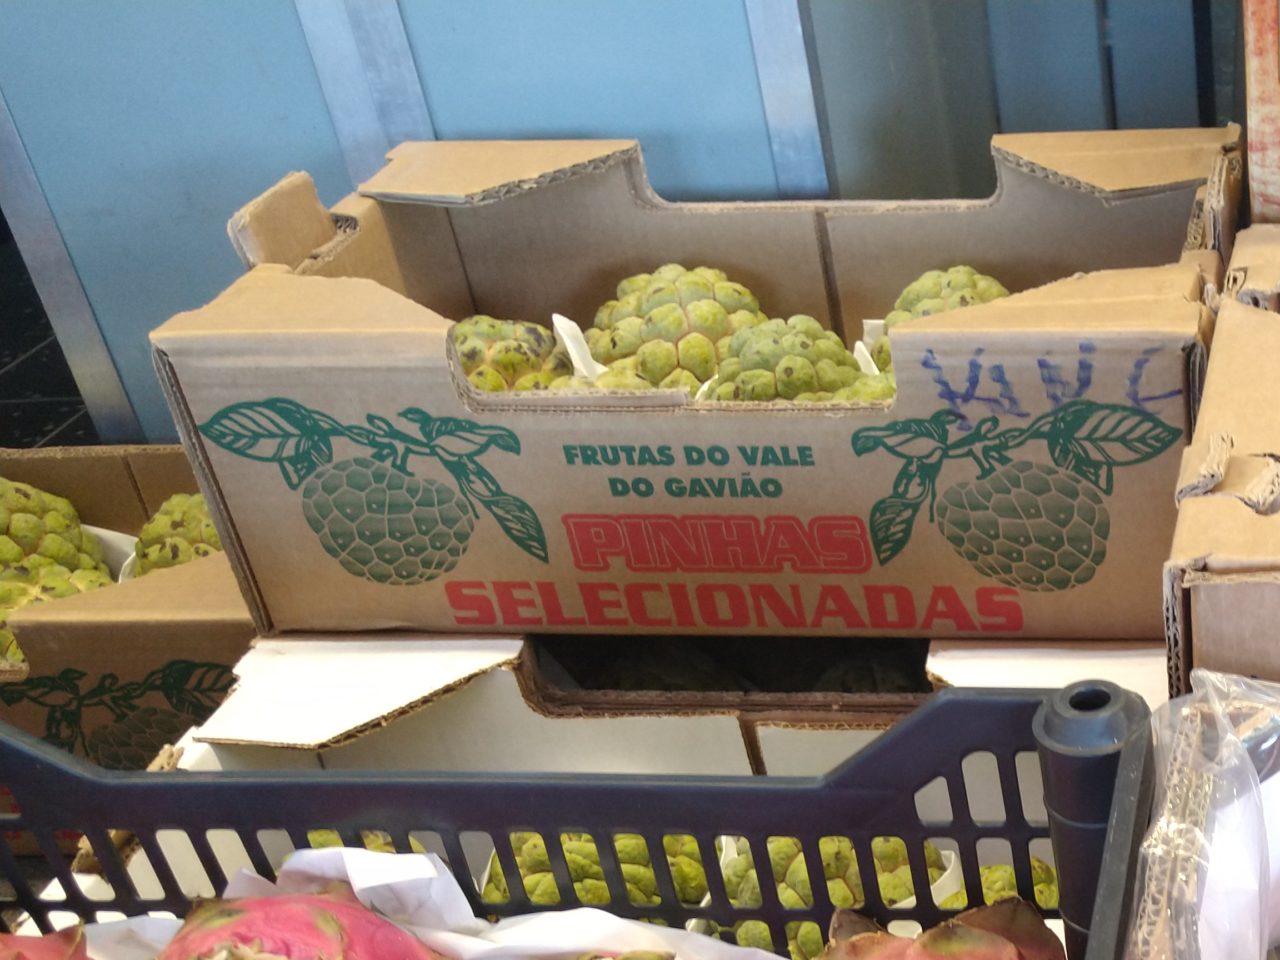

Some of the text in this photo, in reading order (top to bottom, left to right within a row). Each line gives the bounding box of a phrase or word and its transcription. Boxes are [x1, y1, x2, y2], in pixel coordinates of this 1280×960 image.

[562, 443, 815, 468] FRUTAS DO VALE
[608, 468, 783, 498] DO GAVIÃO
[560, 513, 873, 574] PINHAS
[443, 579, 1024, 632] SELECIONADAS
